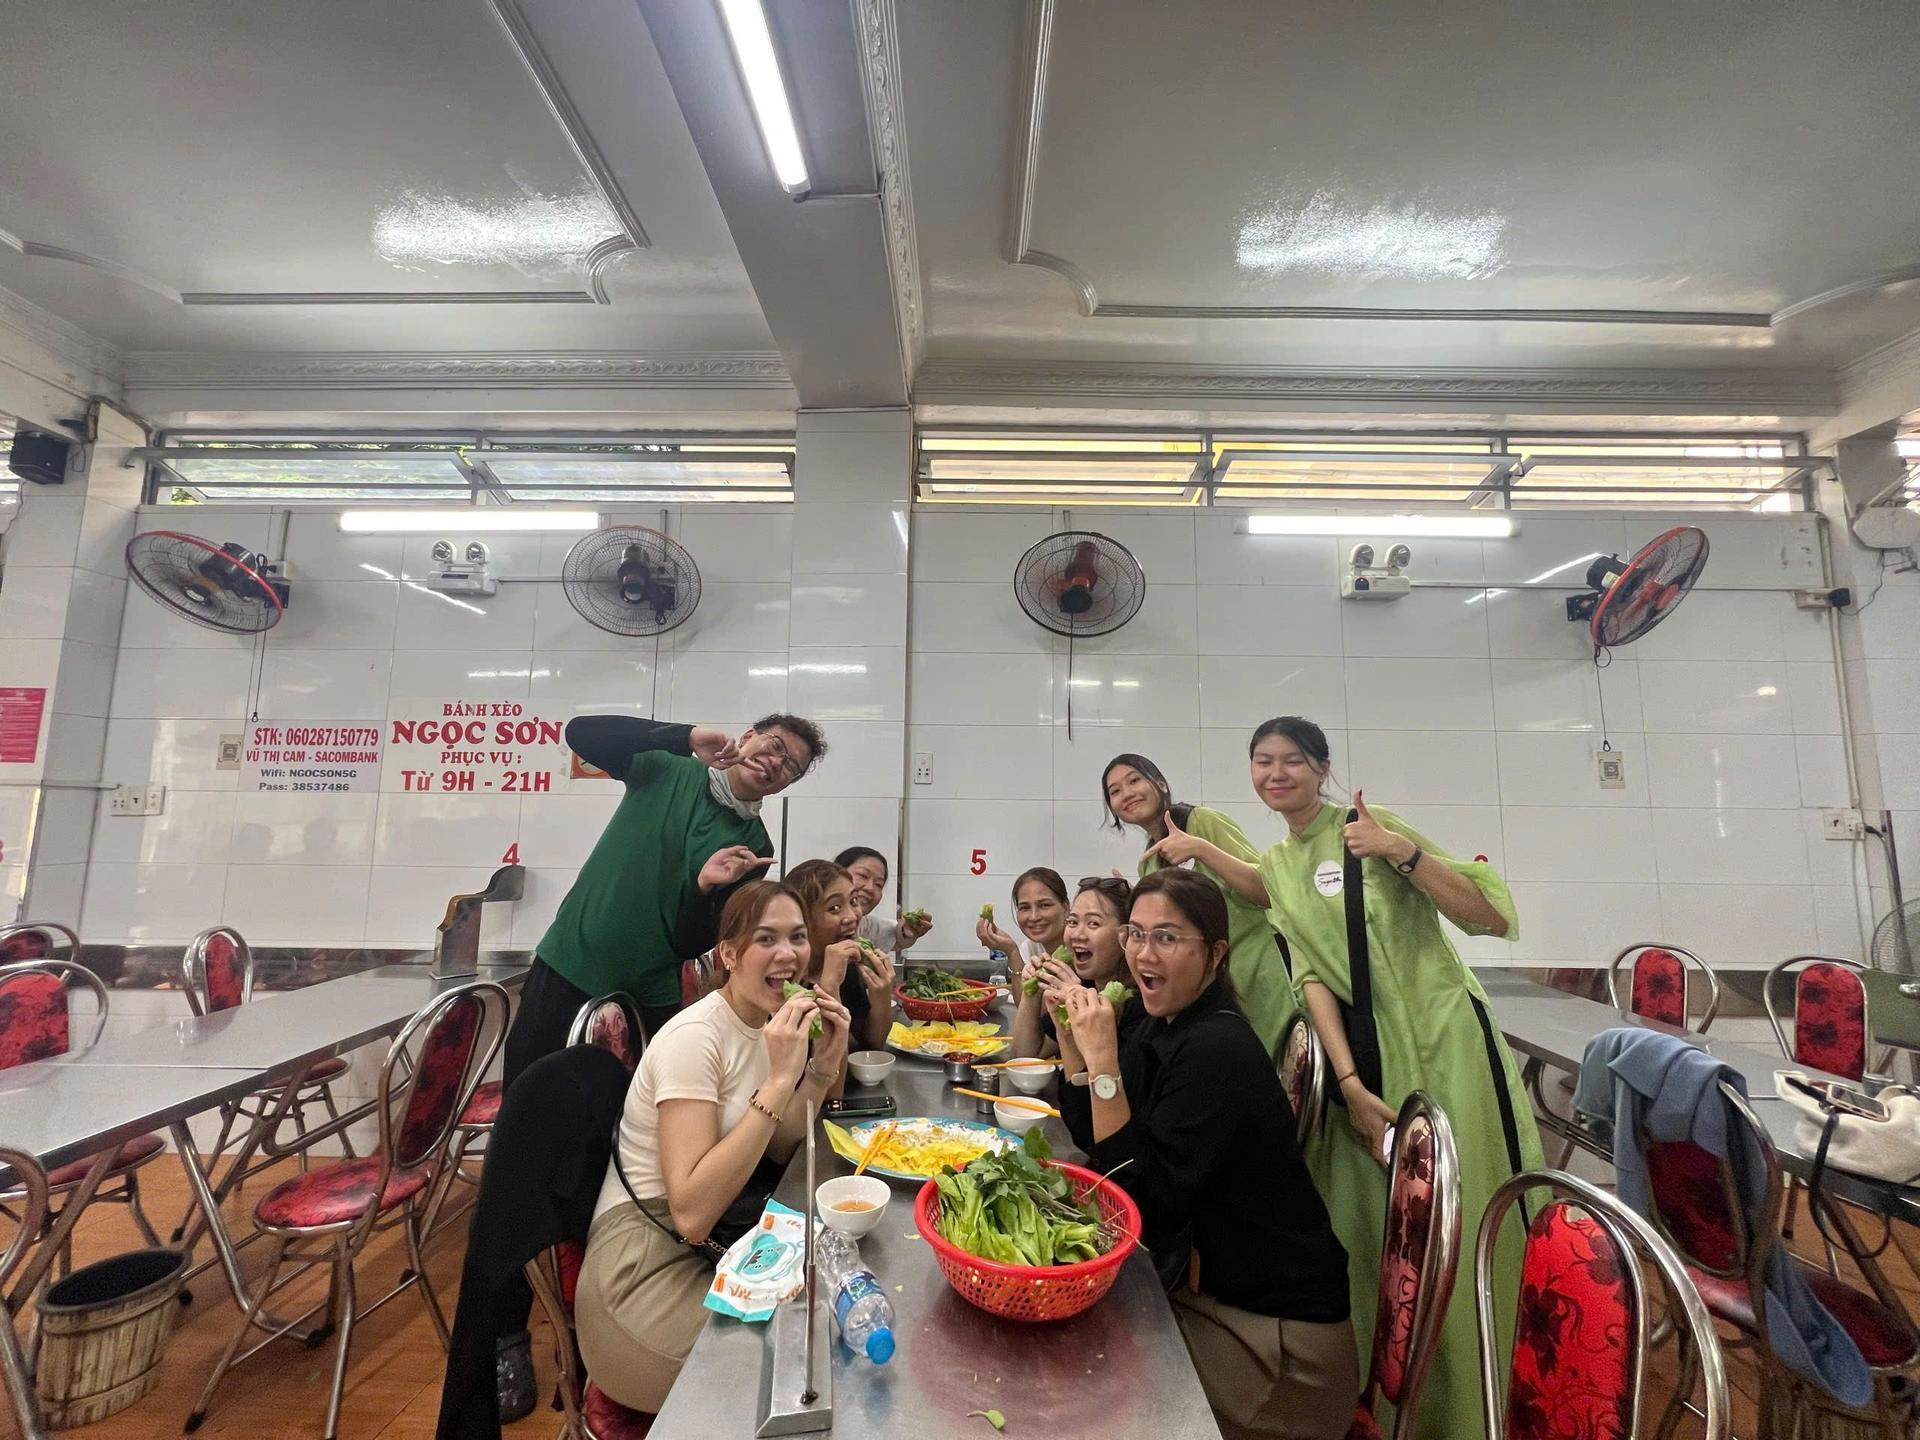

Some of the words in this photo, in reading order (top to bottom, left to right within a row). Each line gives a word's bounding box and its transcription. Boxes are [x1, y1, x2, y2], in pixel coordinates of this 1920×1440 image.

[443, 700, 487, 717] BÁNH
[490, 700, 523, 717] XÈO
[254, 727, 282, 746] STK:
[286, 728, 379, 747] 060287150779
[392, 720, 487, 750] NGỌC
[495, 716, 563, 745] SƠN
[246, 748, 260, 762] VŨ
[263, 750, 280, 765] THỊ
[283, 750, 306, 763] CAM
[315, 751, 378, 763] SACOMBANK
[441, 751, 485, 767] PHỤC
[489, 751, 513, 767] VỤ
[260, 768, 286, 778] Wifi:
[289, 769, 357, 778] NGOCSON5G
[401, 770, 434, 791] Từ
[442, 770, 475, 792] 9H
[501, 771, 551, 792] 21H
[259, 782, 288, 791] Pass:
[291, 783, 350, 791] 38537486
[502, 842, 520, 866] 4
[970, 849, 987, 875] 5
